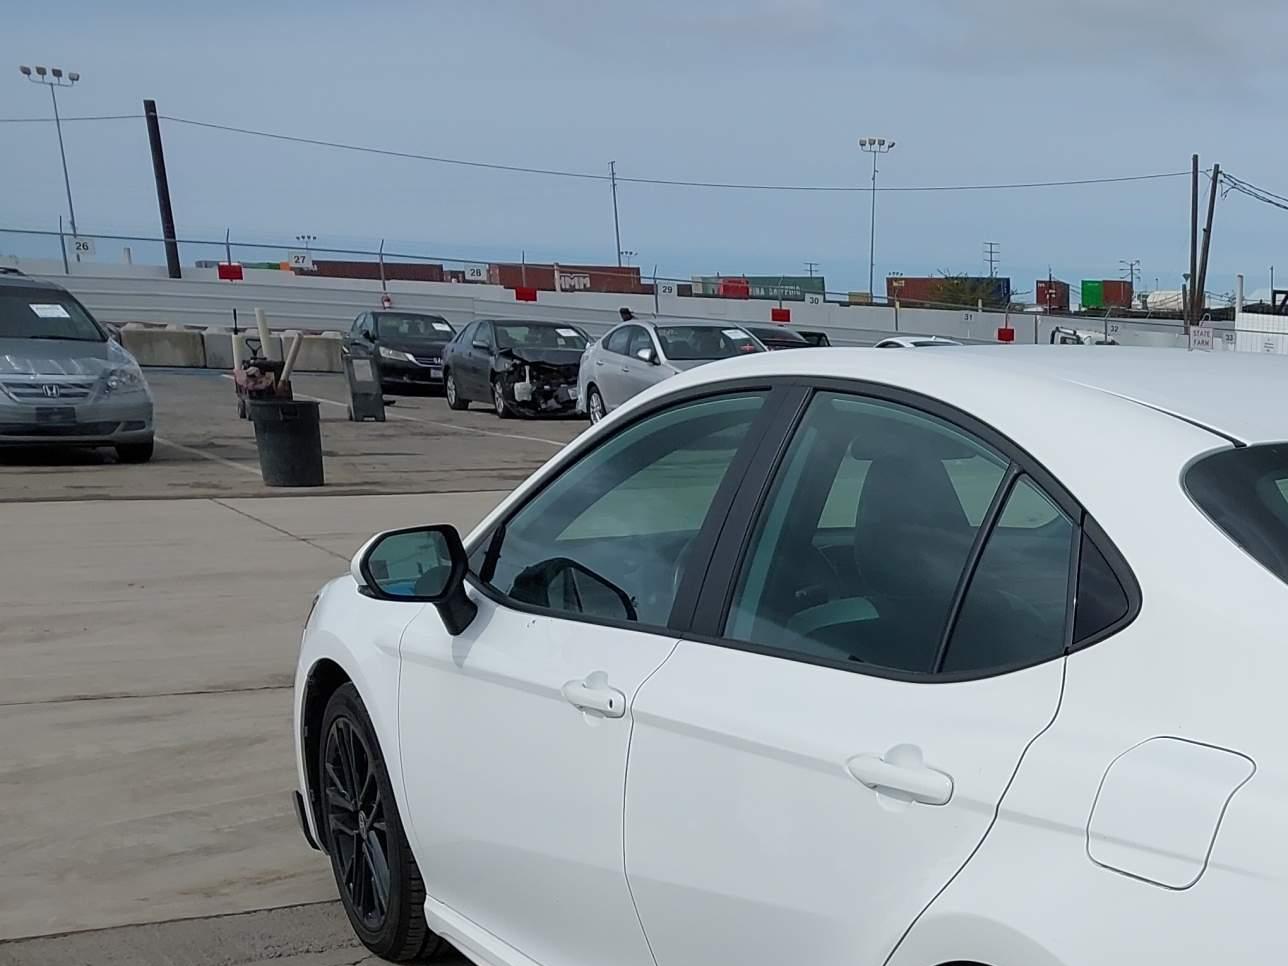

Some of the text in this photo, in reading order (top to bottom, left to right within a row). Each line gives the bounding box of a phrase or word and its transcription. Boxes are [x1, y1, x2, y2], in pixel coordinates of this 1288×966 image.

[75, 242, 89, 251] 26
[293, 255, 306, 264] 27
[470, 268, 482, 277] 28
[662, 285, 673, 294] 29
[809, 296, 819, 305] 30
[1192, 329, 1211, 338] STATE
[1193, 338, 1210, 347] FARM
